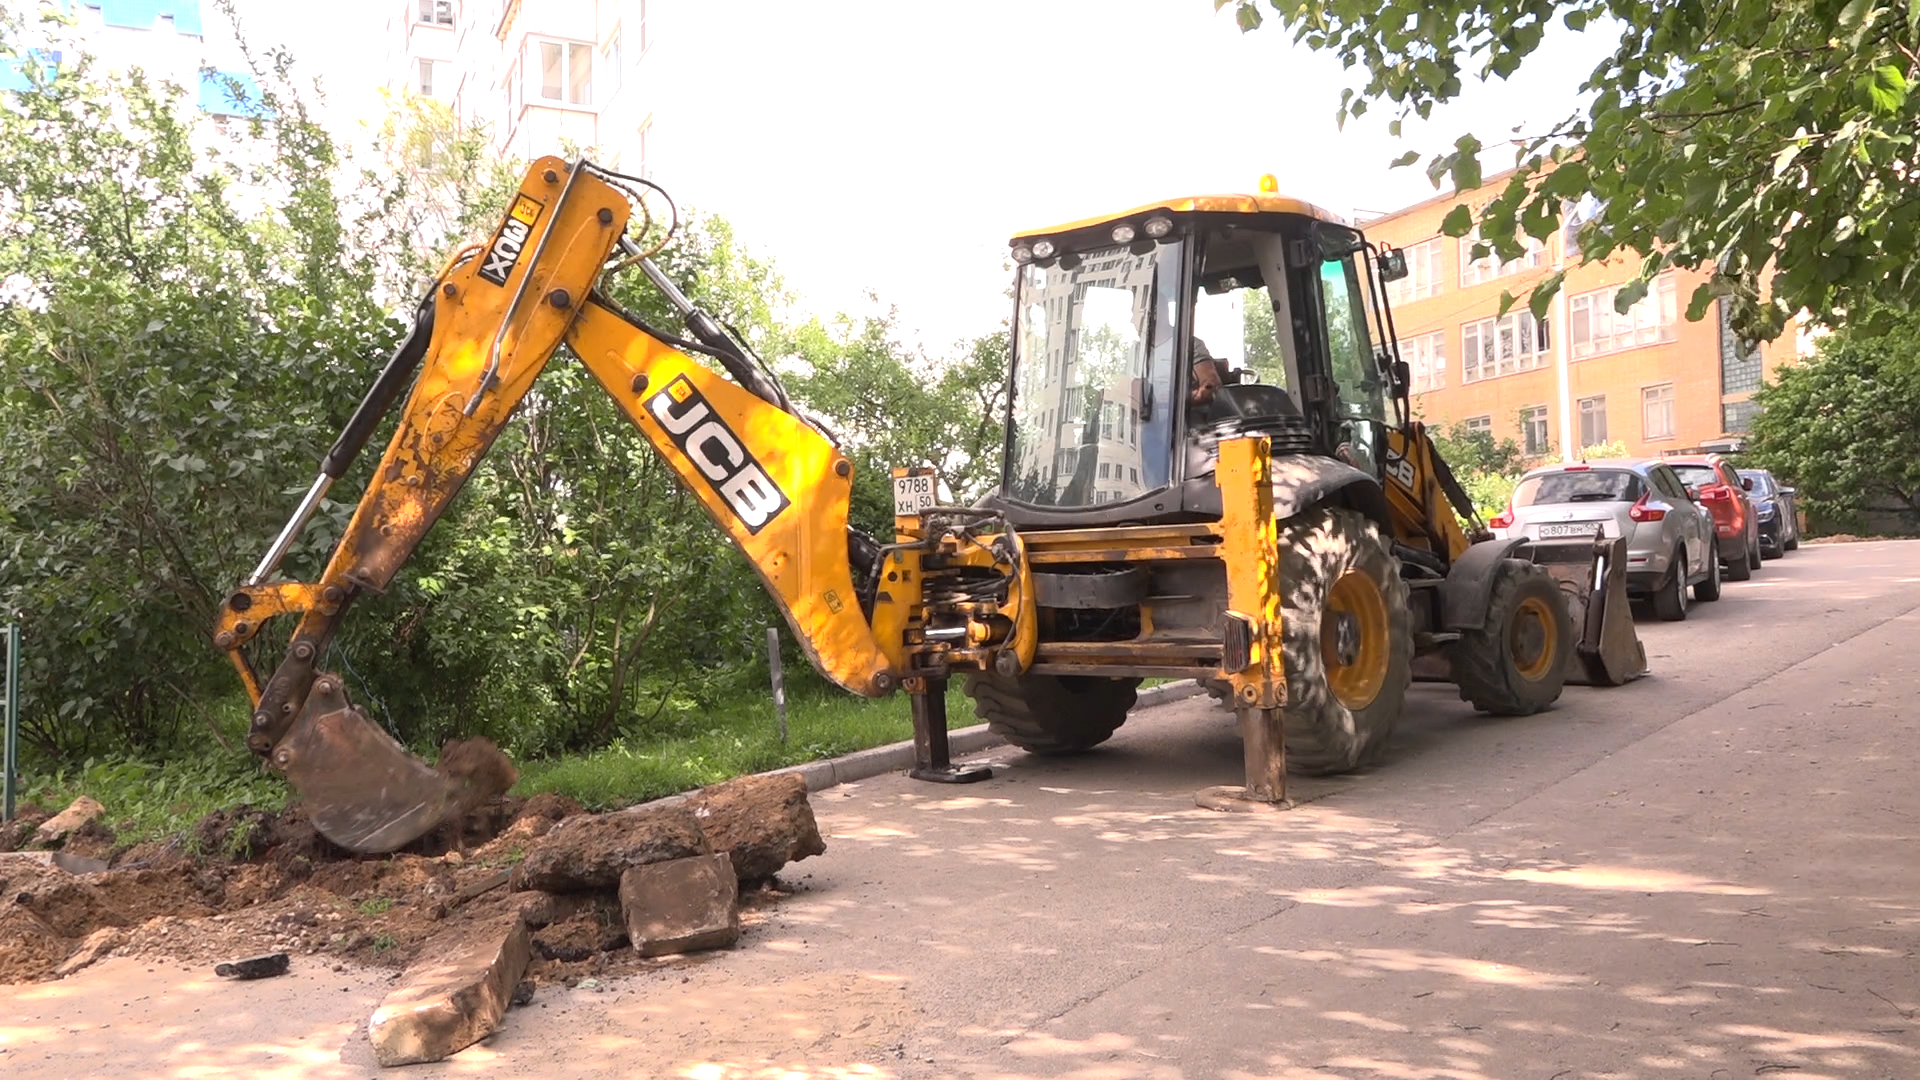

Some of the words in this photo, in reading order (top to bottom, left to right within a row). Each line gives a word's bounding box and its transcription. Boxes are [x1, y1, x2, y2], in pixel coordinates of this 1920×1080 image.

[482, 218, 530, 280] 3CX
[652, 392, 782, 527] JCB
[1386, 448, 1414, 488] CB
[898, 478, 929, 494] 9788
[920, 495, 932, 507] 50
